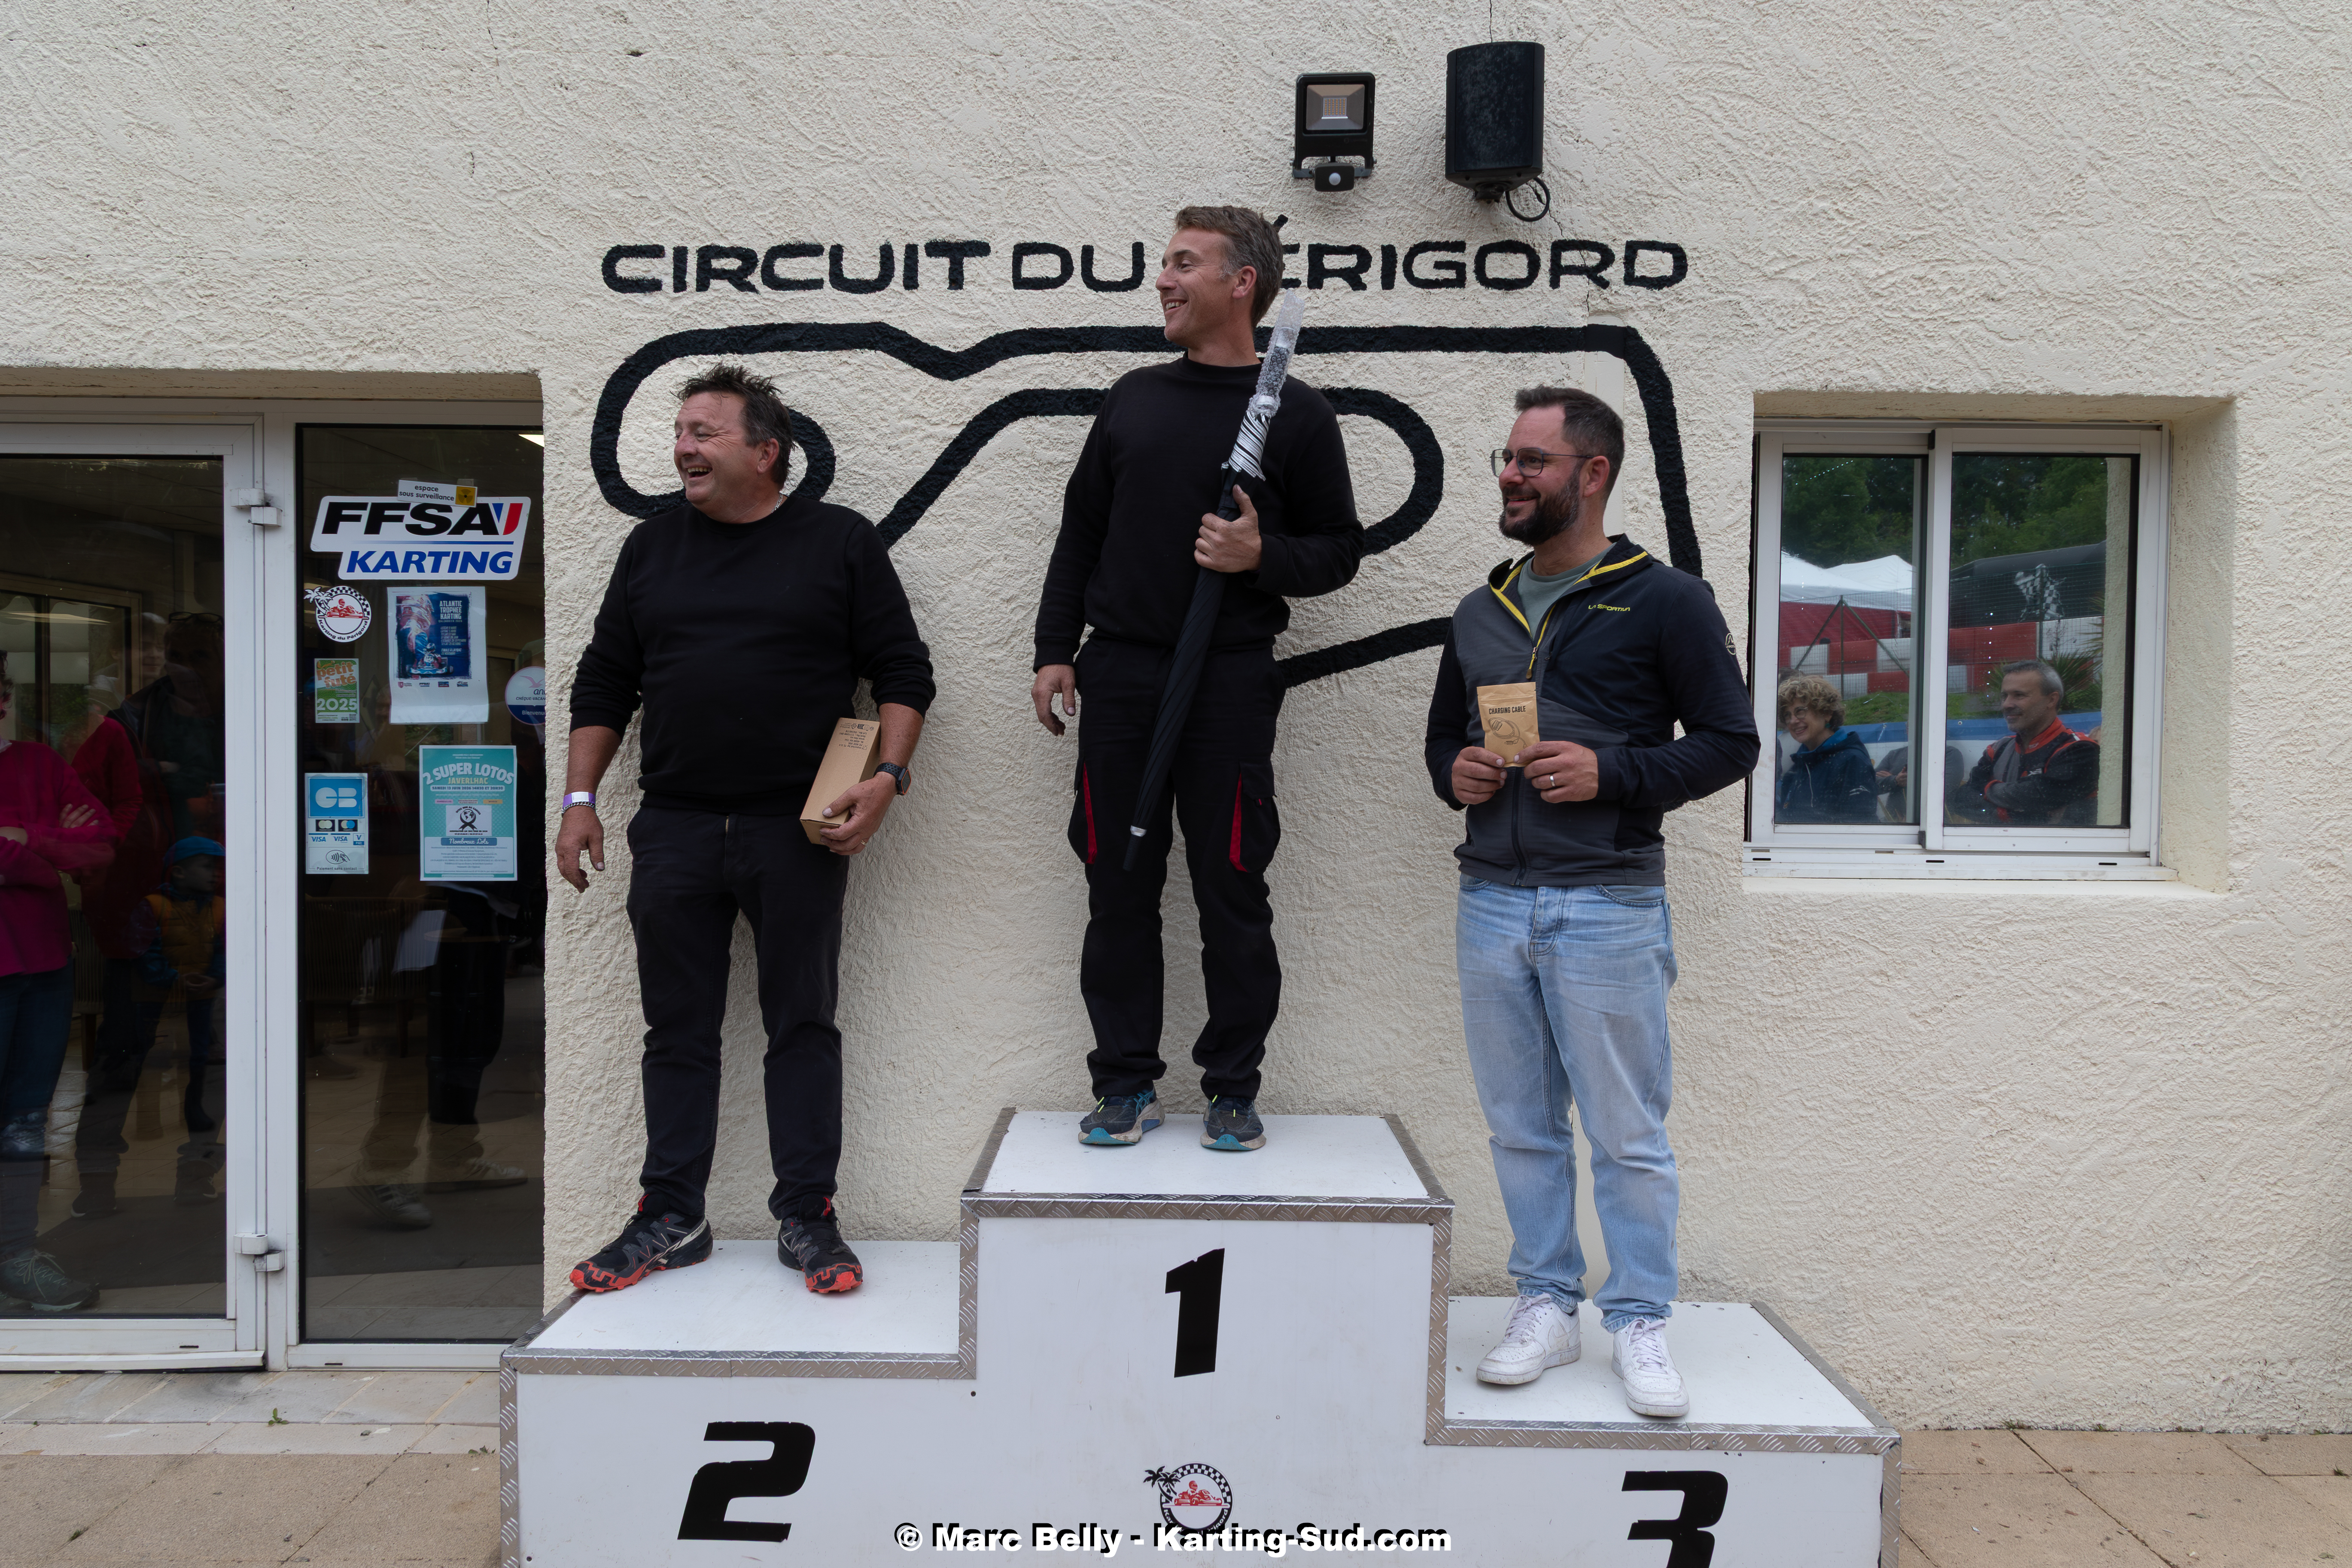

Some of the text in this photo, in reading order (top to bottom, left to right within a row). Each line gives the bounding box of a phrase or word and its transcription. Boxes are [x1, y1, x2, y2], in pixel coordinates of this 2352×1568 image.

[601, 214, 1688, 294] CIRCUIT DU RIGORD
[321, 502, 499, 536] FFSA
[346, 551, 514, 574] KARTING
[319, 619, 336, 639] Karting
[347, 621, 368, 640] Périgord
[316, 661, 354, 681] petit
[324, 673, 356, 688] futé
[316, 698, 357, 710] 2025
[423, 762, 514, 785] 2 SUPER LOTOS
[691, 1223, 703, 1237] SPEED
[1165, 1248, 1225, 1378] 1
[677, 1422, 815, 1543] 2
[1622, 1471, 1728, 1568] 3
